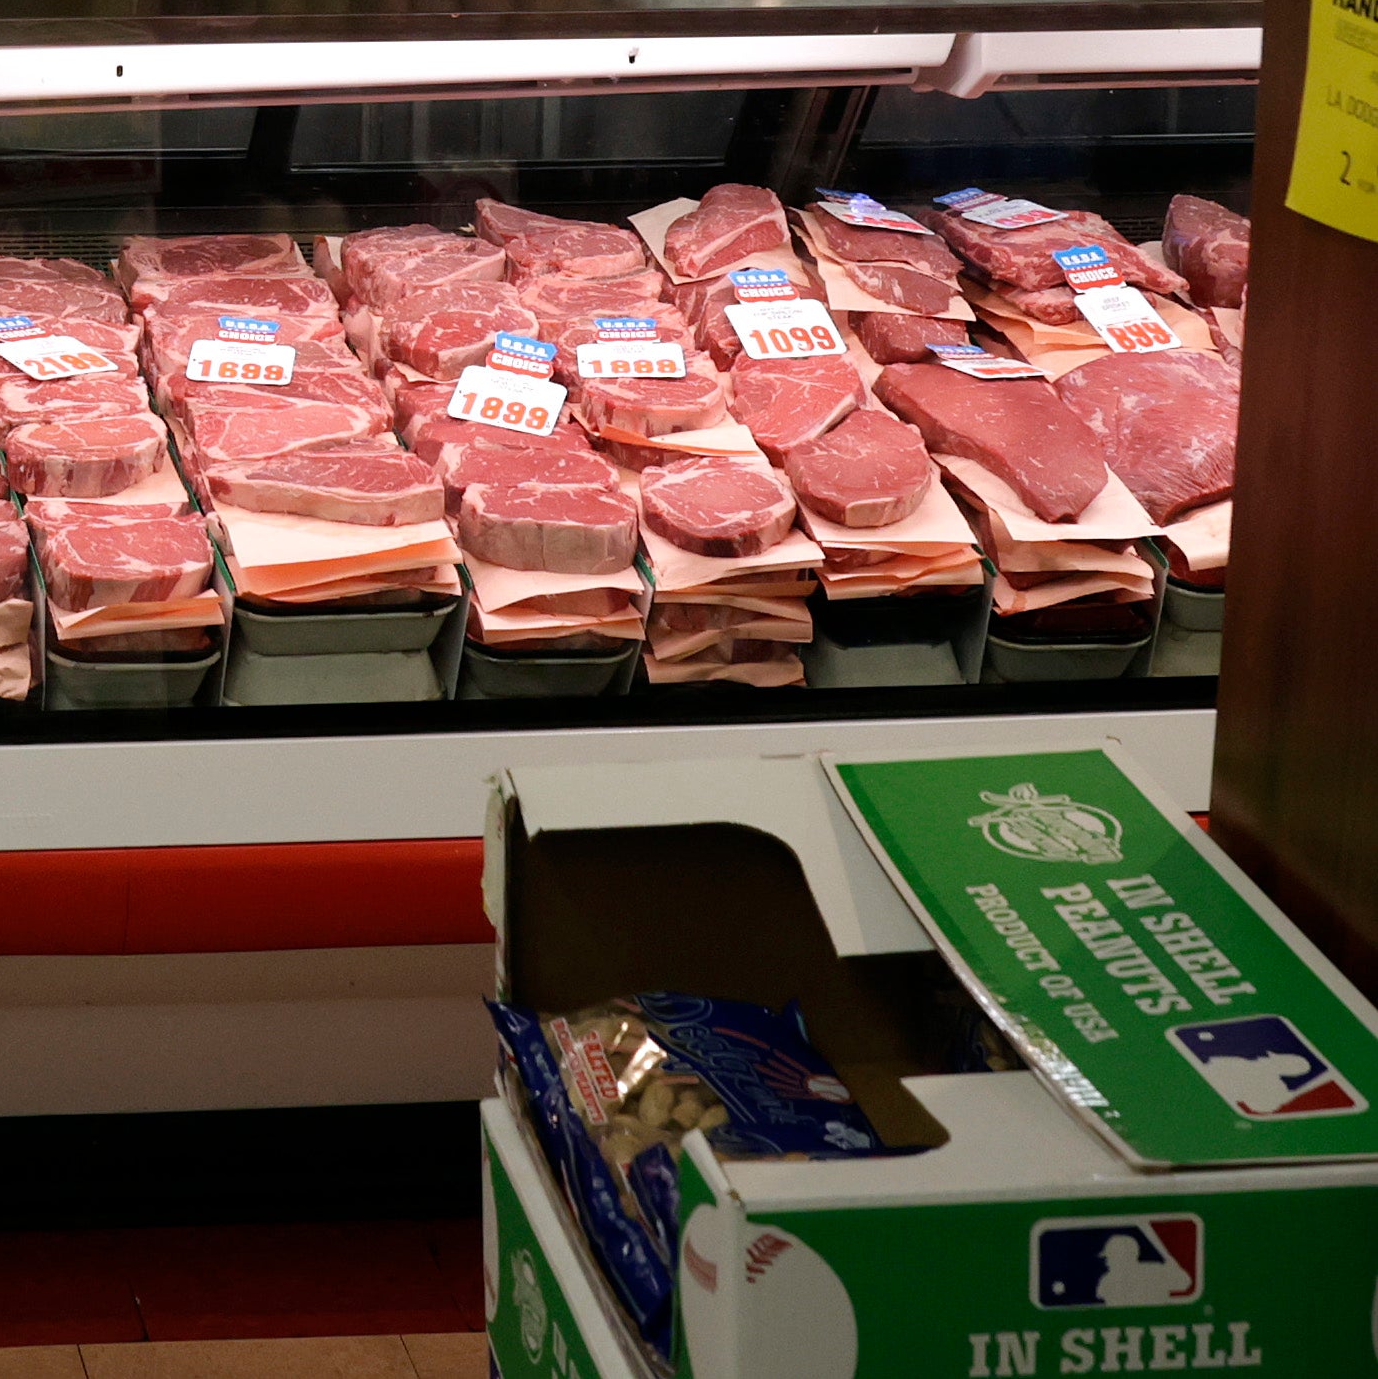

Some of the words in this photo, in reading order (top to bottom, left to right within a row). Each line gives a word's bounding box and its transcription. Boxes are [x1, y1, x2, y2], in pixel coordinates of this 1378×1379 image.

[1069, 267, 1119, 284] CHOICE
[738, 285, 795, 298] CHOICE
[219, 330, 276, 342] CHOICE
[749, 325, 836, 354] 1099
[1106, 321, 1171, 351] 899
[198, 359, 284, 381] 1699
[491, 352, 550, 374] CHOICE
[462, 392, 549, 430] 1899
[1106, 873, 1175, 909] IN
[965, 883, 1061, 972] PRODUCT
[1038, 974, 1085, 1000] OF
[1063, 1002, 1120, 1044] USA
[1040, 882, 1192, 1015] PEANUTS
[1139, 911, 1257, 1005] SHELL
[968, 1330, 1041, 1378] IN
[1059, 1321, 1262, 1375] SHELL
